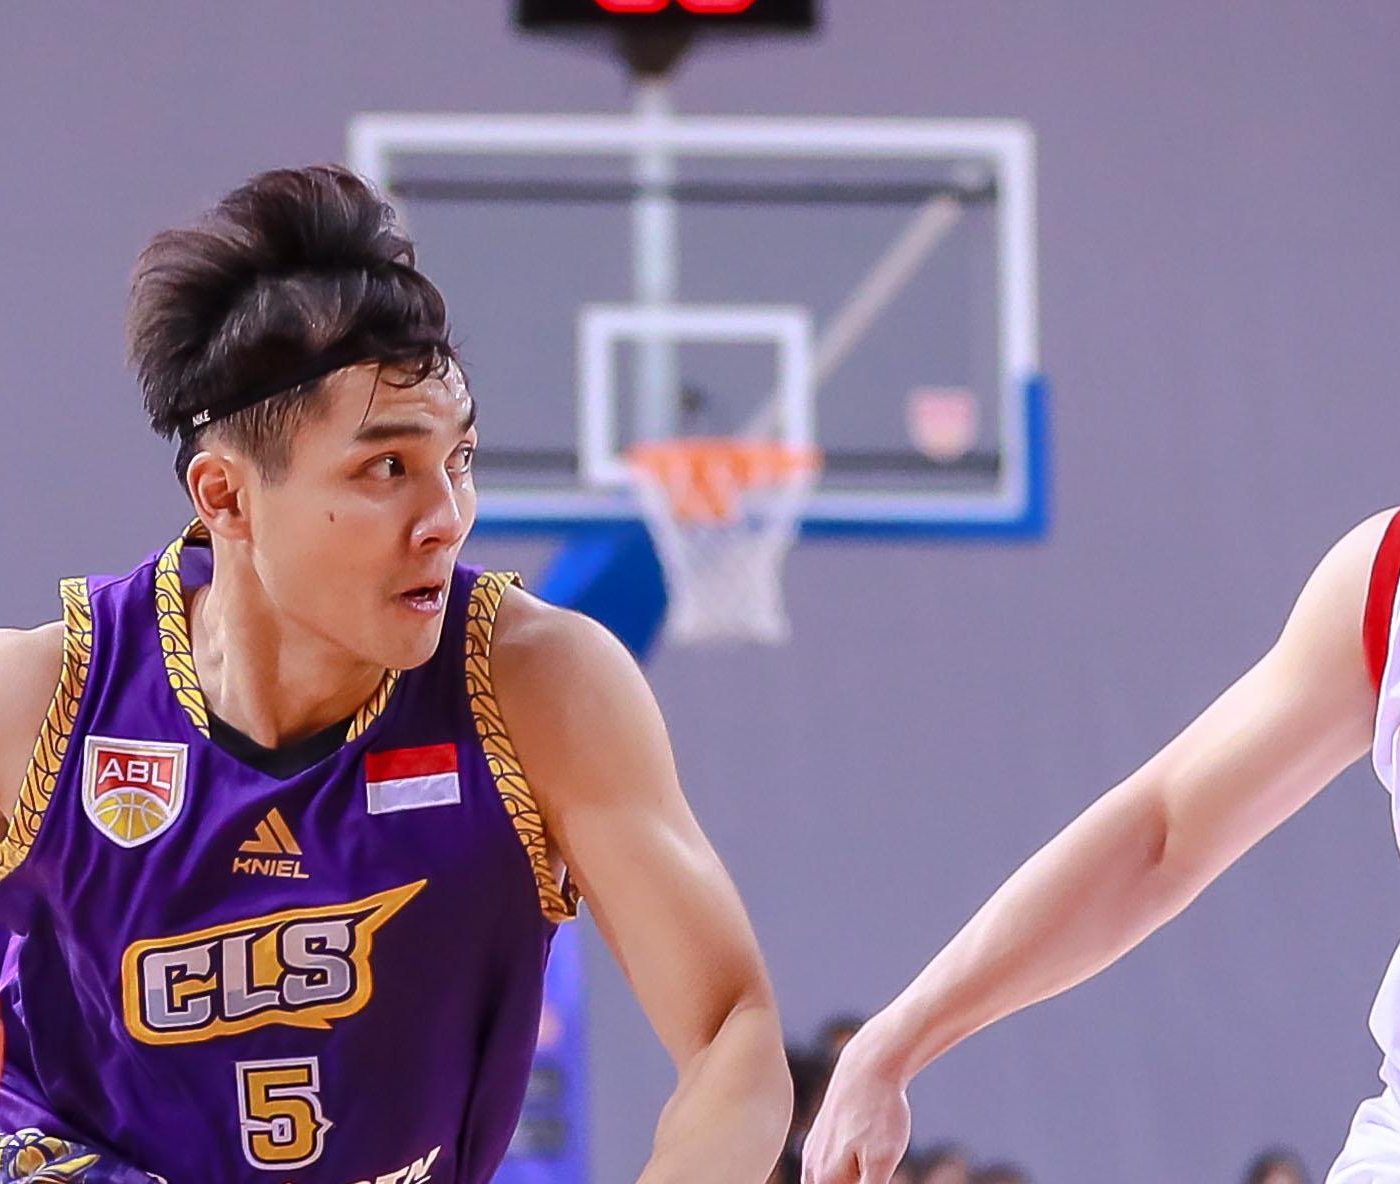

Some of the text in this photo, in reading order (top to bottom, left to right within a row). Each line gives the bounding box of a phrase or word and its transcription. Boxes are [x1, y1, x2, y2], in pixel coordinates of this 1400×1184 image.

[97, 758, 171, 791] ABL
[141, 917, 356, 1029] CLS
[236, 1057, 333, 1170] 5
